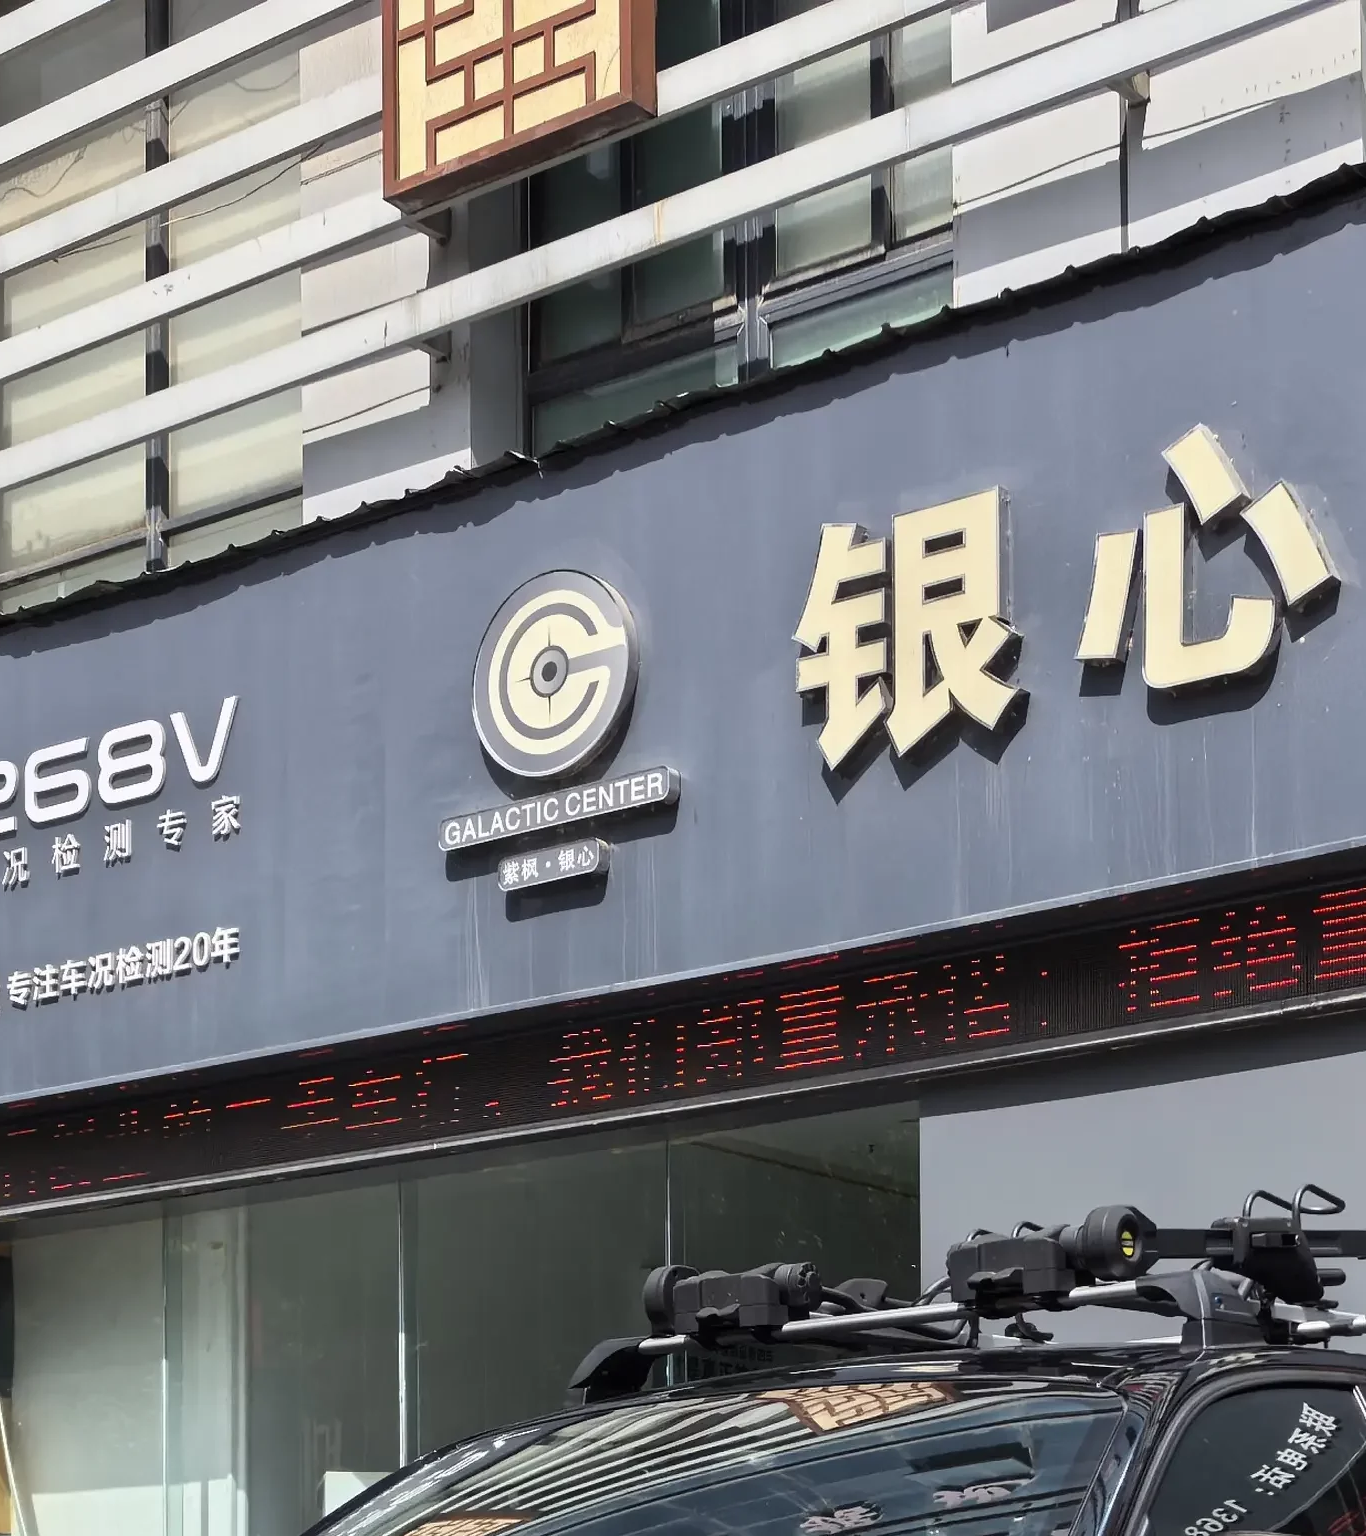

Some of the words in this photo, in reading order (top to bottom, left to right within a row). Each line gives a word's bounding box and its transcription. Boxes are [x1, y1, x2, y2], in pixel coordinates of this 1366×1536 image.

[443, 796, 559, 850] GALACTIC
[563, 771, 665, 822] CENTER
[6, 925, 241, 1006] 专注车况检测20年
